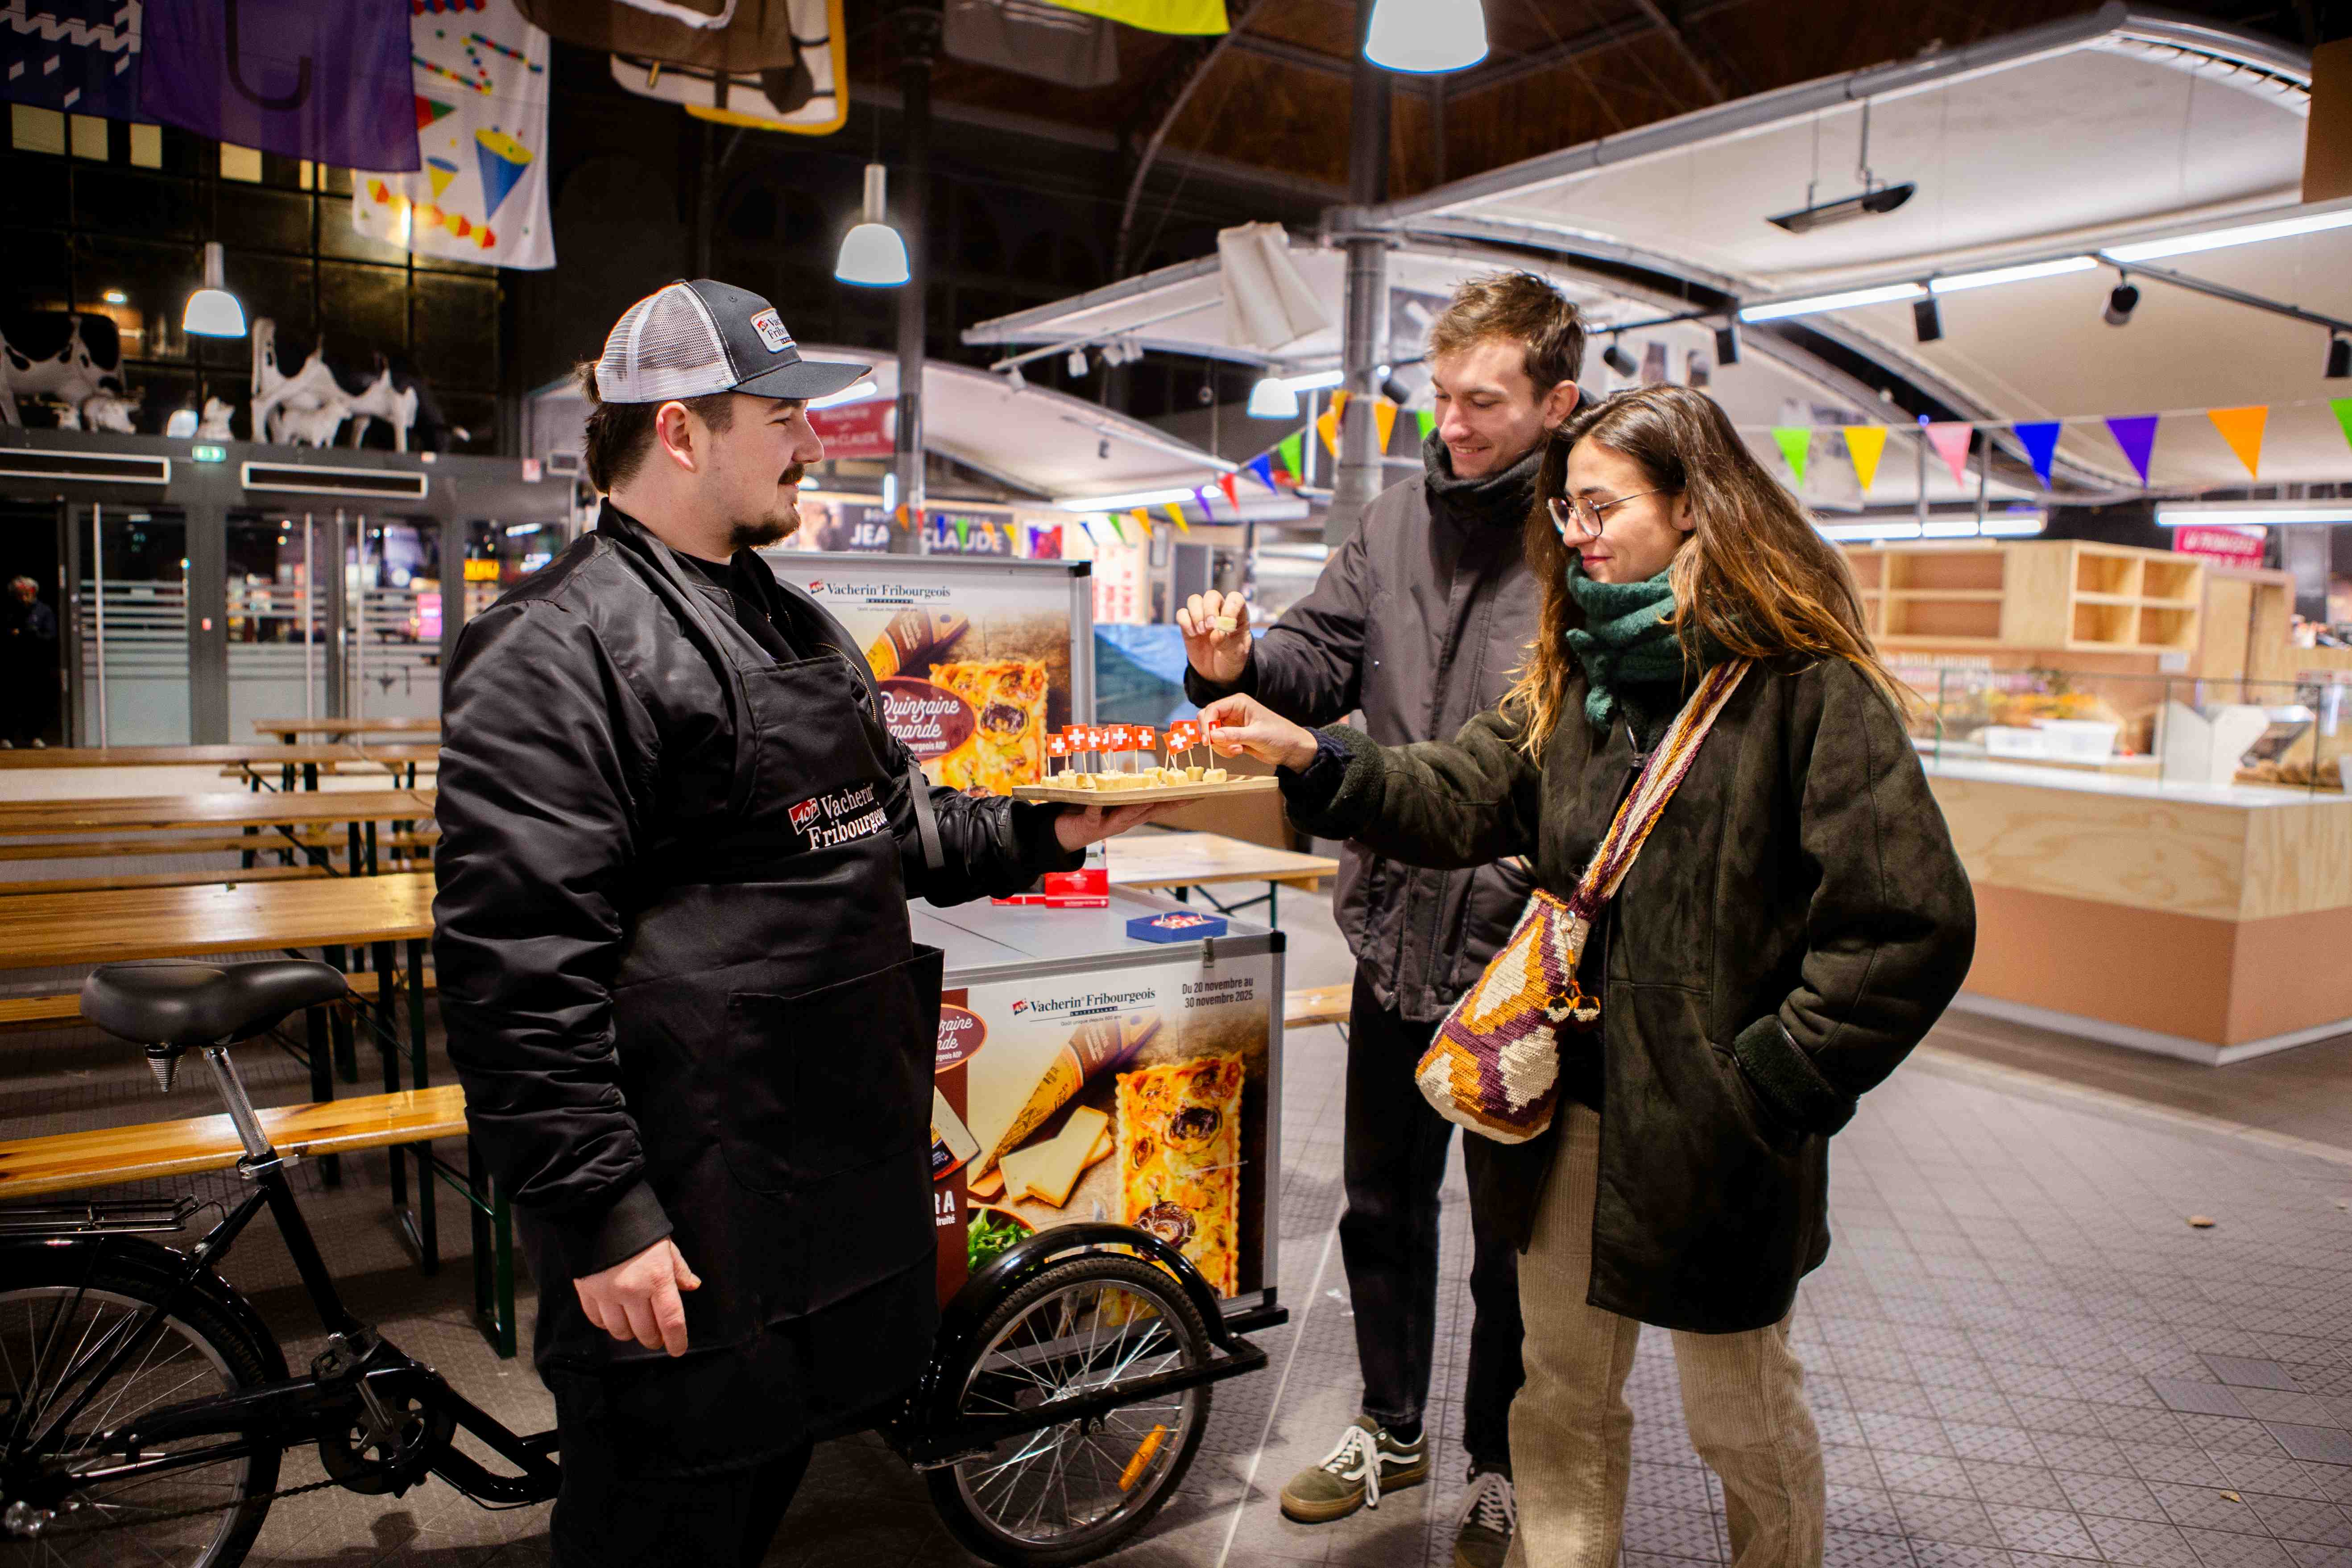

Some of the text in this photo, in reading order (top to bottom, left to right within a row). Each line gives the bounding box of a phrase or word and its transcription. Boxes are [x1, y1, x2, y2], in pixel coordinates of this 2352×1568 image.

[849, 523, 890, 546] JEA
[827, 583, 876, 595] Vacherin
[882, 584, 951, 598] Fribourgeois
[880, 691, 960, 723] Quinzaine
[888, 715, 942, 739] mande
[906, 742, 934, 752] ourgeois
[1182, 977, 1253, 994] Du 20 novembre au
[1030, 997, 1081, 1013] Vacherin
[1086, 988, 1155, 1006] Fribourgeois
[1184, 990, 1253, 1008] 30 novembre 2025
[938, 1015, 973, 1039] zaine
[936, 1214, 955, 1227] fruité
